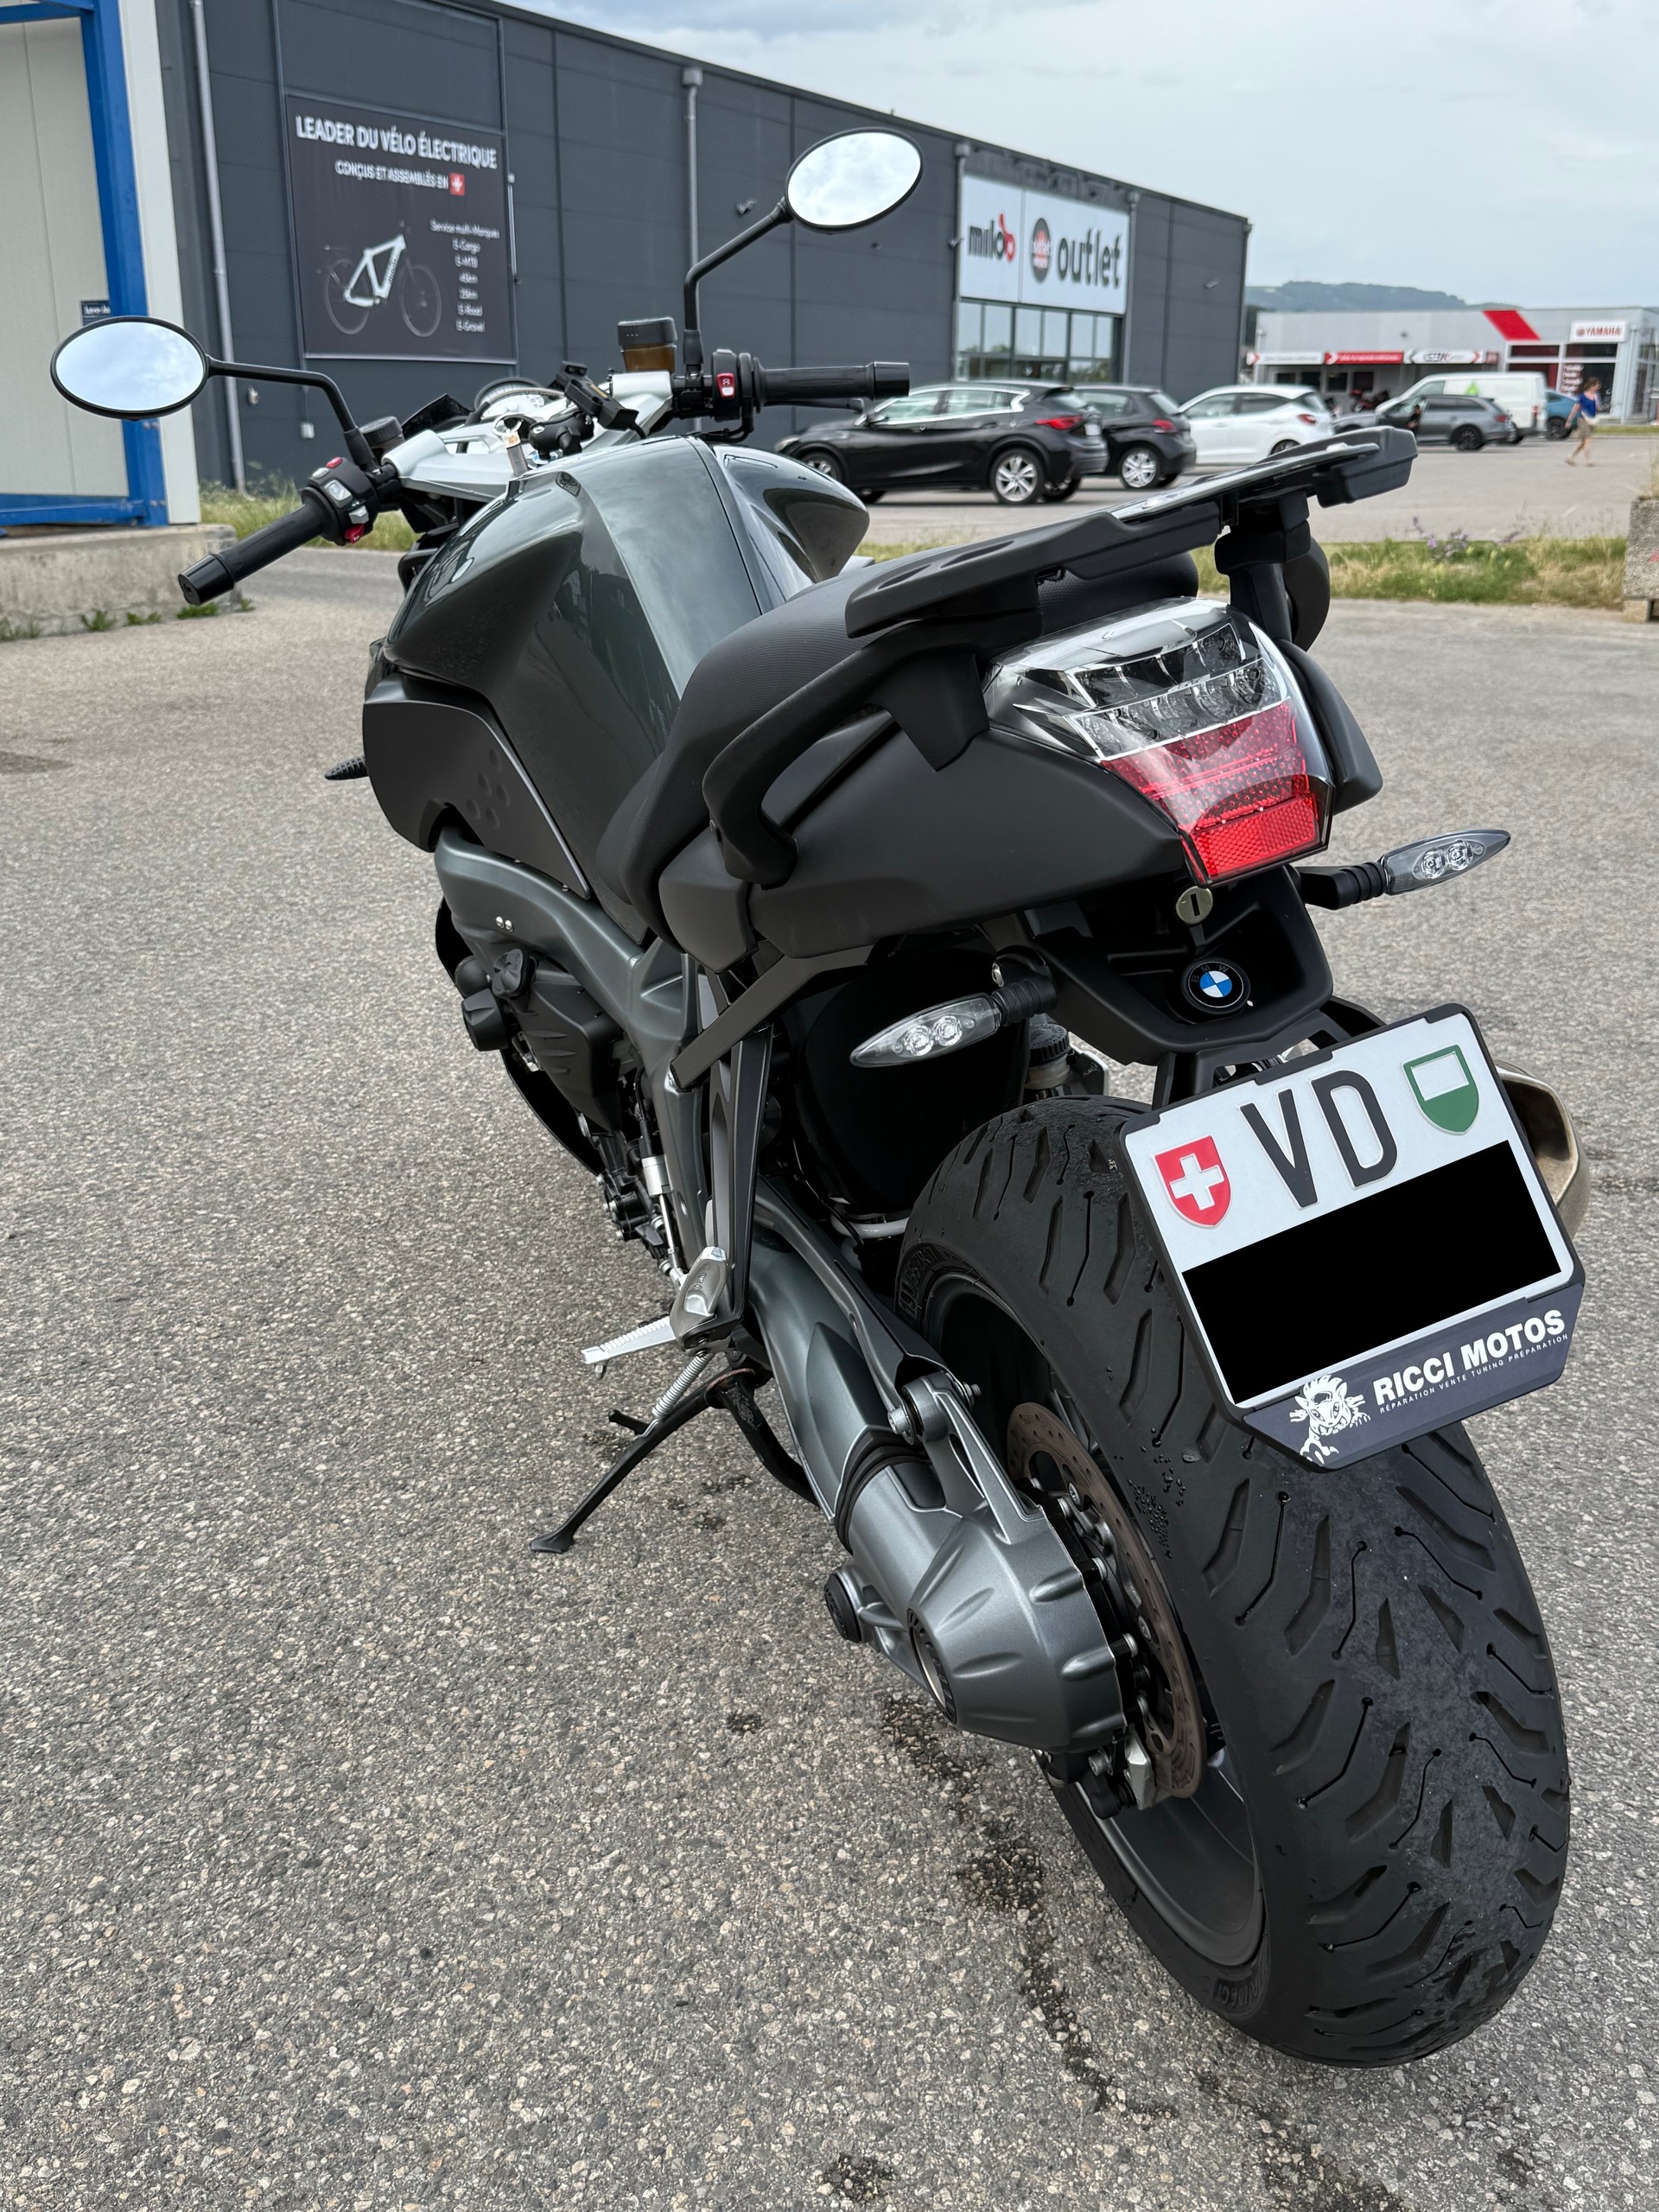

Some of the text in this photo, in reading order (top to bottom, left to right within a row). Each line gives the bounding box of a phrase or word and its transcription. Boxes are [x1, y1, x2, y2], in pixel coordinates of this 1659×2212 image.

[296, 115, 498, 169] LEADER DU VÉLO ÉLECTRIQUE
[335, 159, 449, 189] CONÇUS ET ASSEMBLÉS EN
[1058, 229, 1121, 289] outlet
[1586, 327, 1621, 337] YAMAHA
[1192, 963, 1228, 982] BMW
[1239, 1071, 1398, 1208] VD
[1373, 1309, 1566, 1406] RICCI MOTOS
[1380, 1333, 1568, 1414] RÉPARATION VENTE TUNING PRÉPARATION
